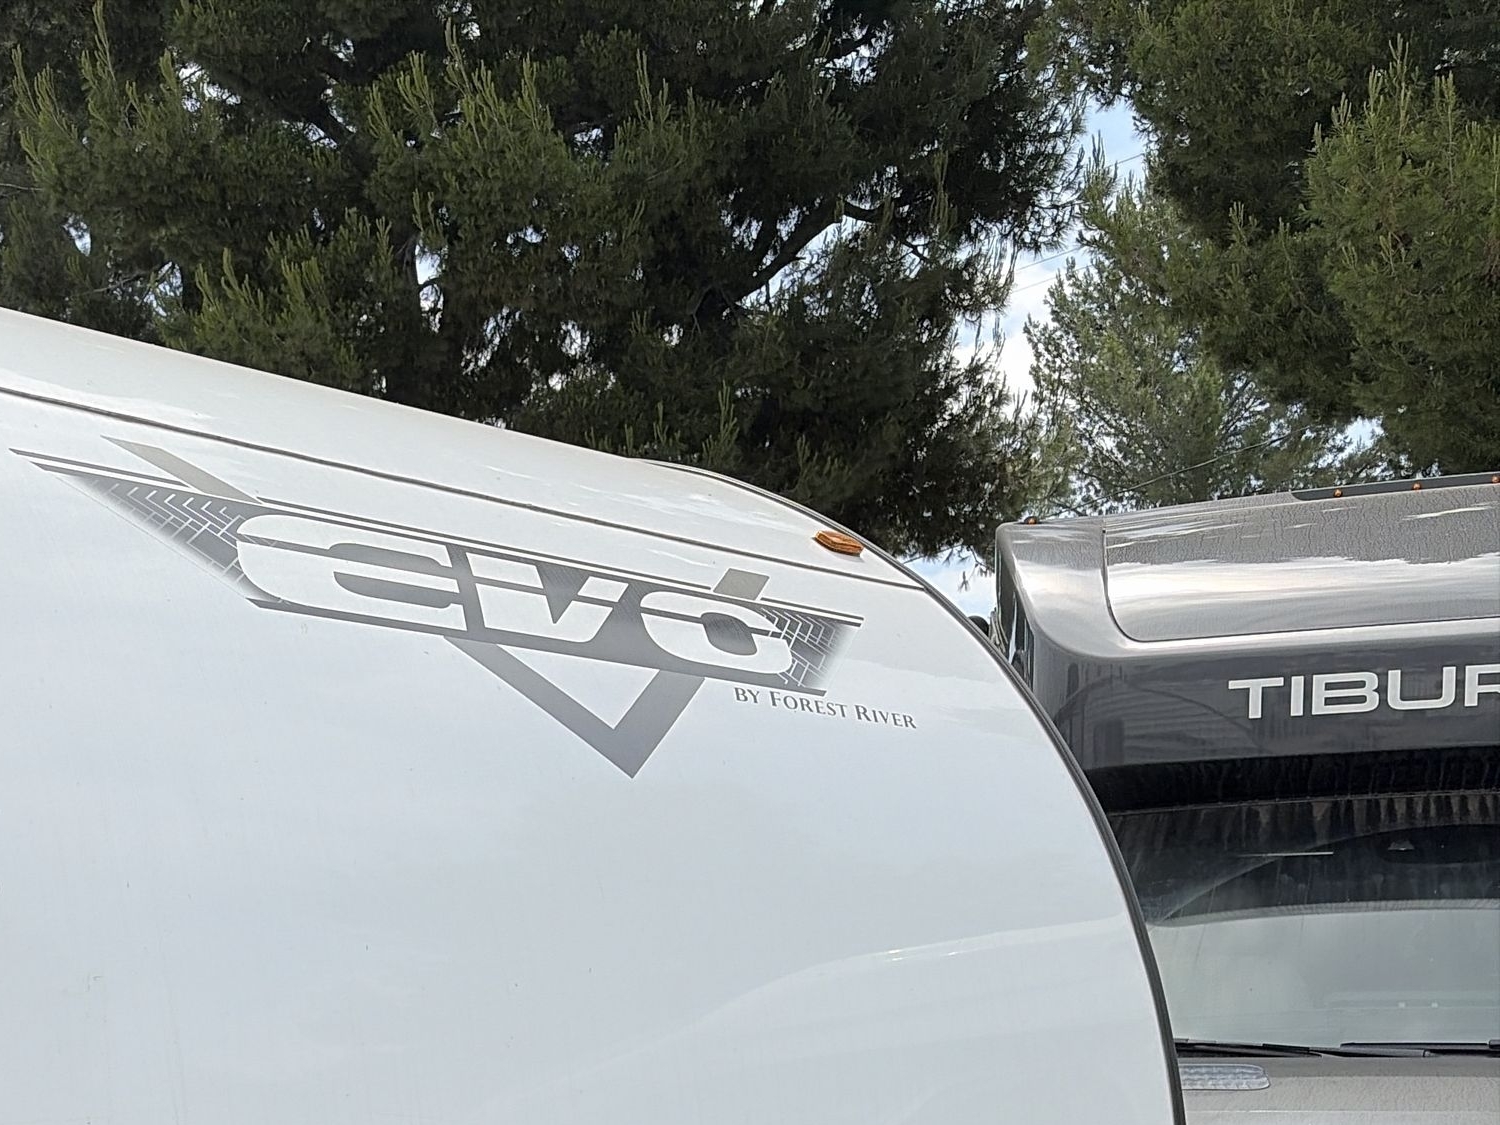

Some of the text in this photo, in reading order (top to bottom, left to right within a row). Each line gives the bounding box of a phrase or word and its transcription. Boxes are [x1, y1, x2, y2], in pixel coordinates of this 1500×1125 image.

[236, 513, 793, 675] EVO
[734, 687, 917, 729] BY FOREST RIVER
